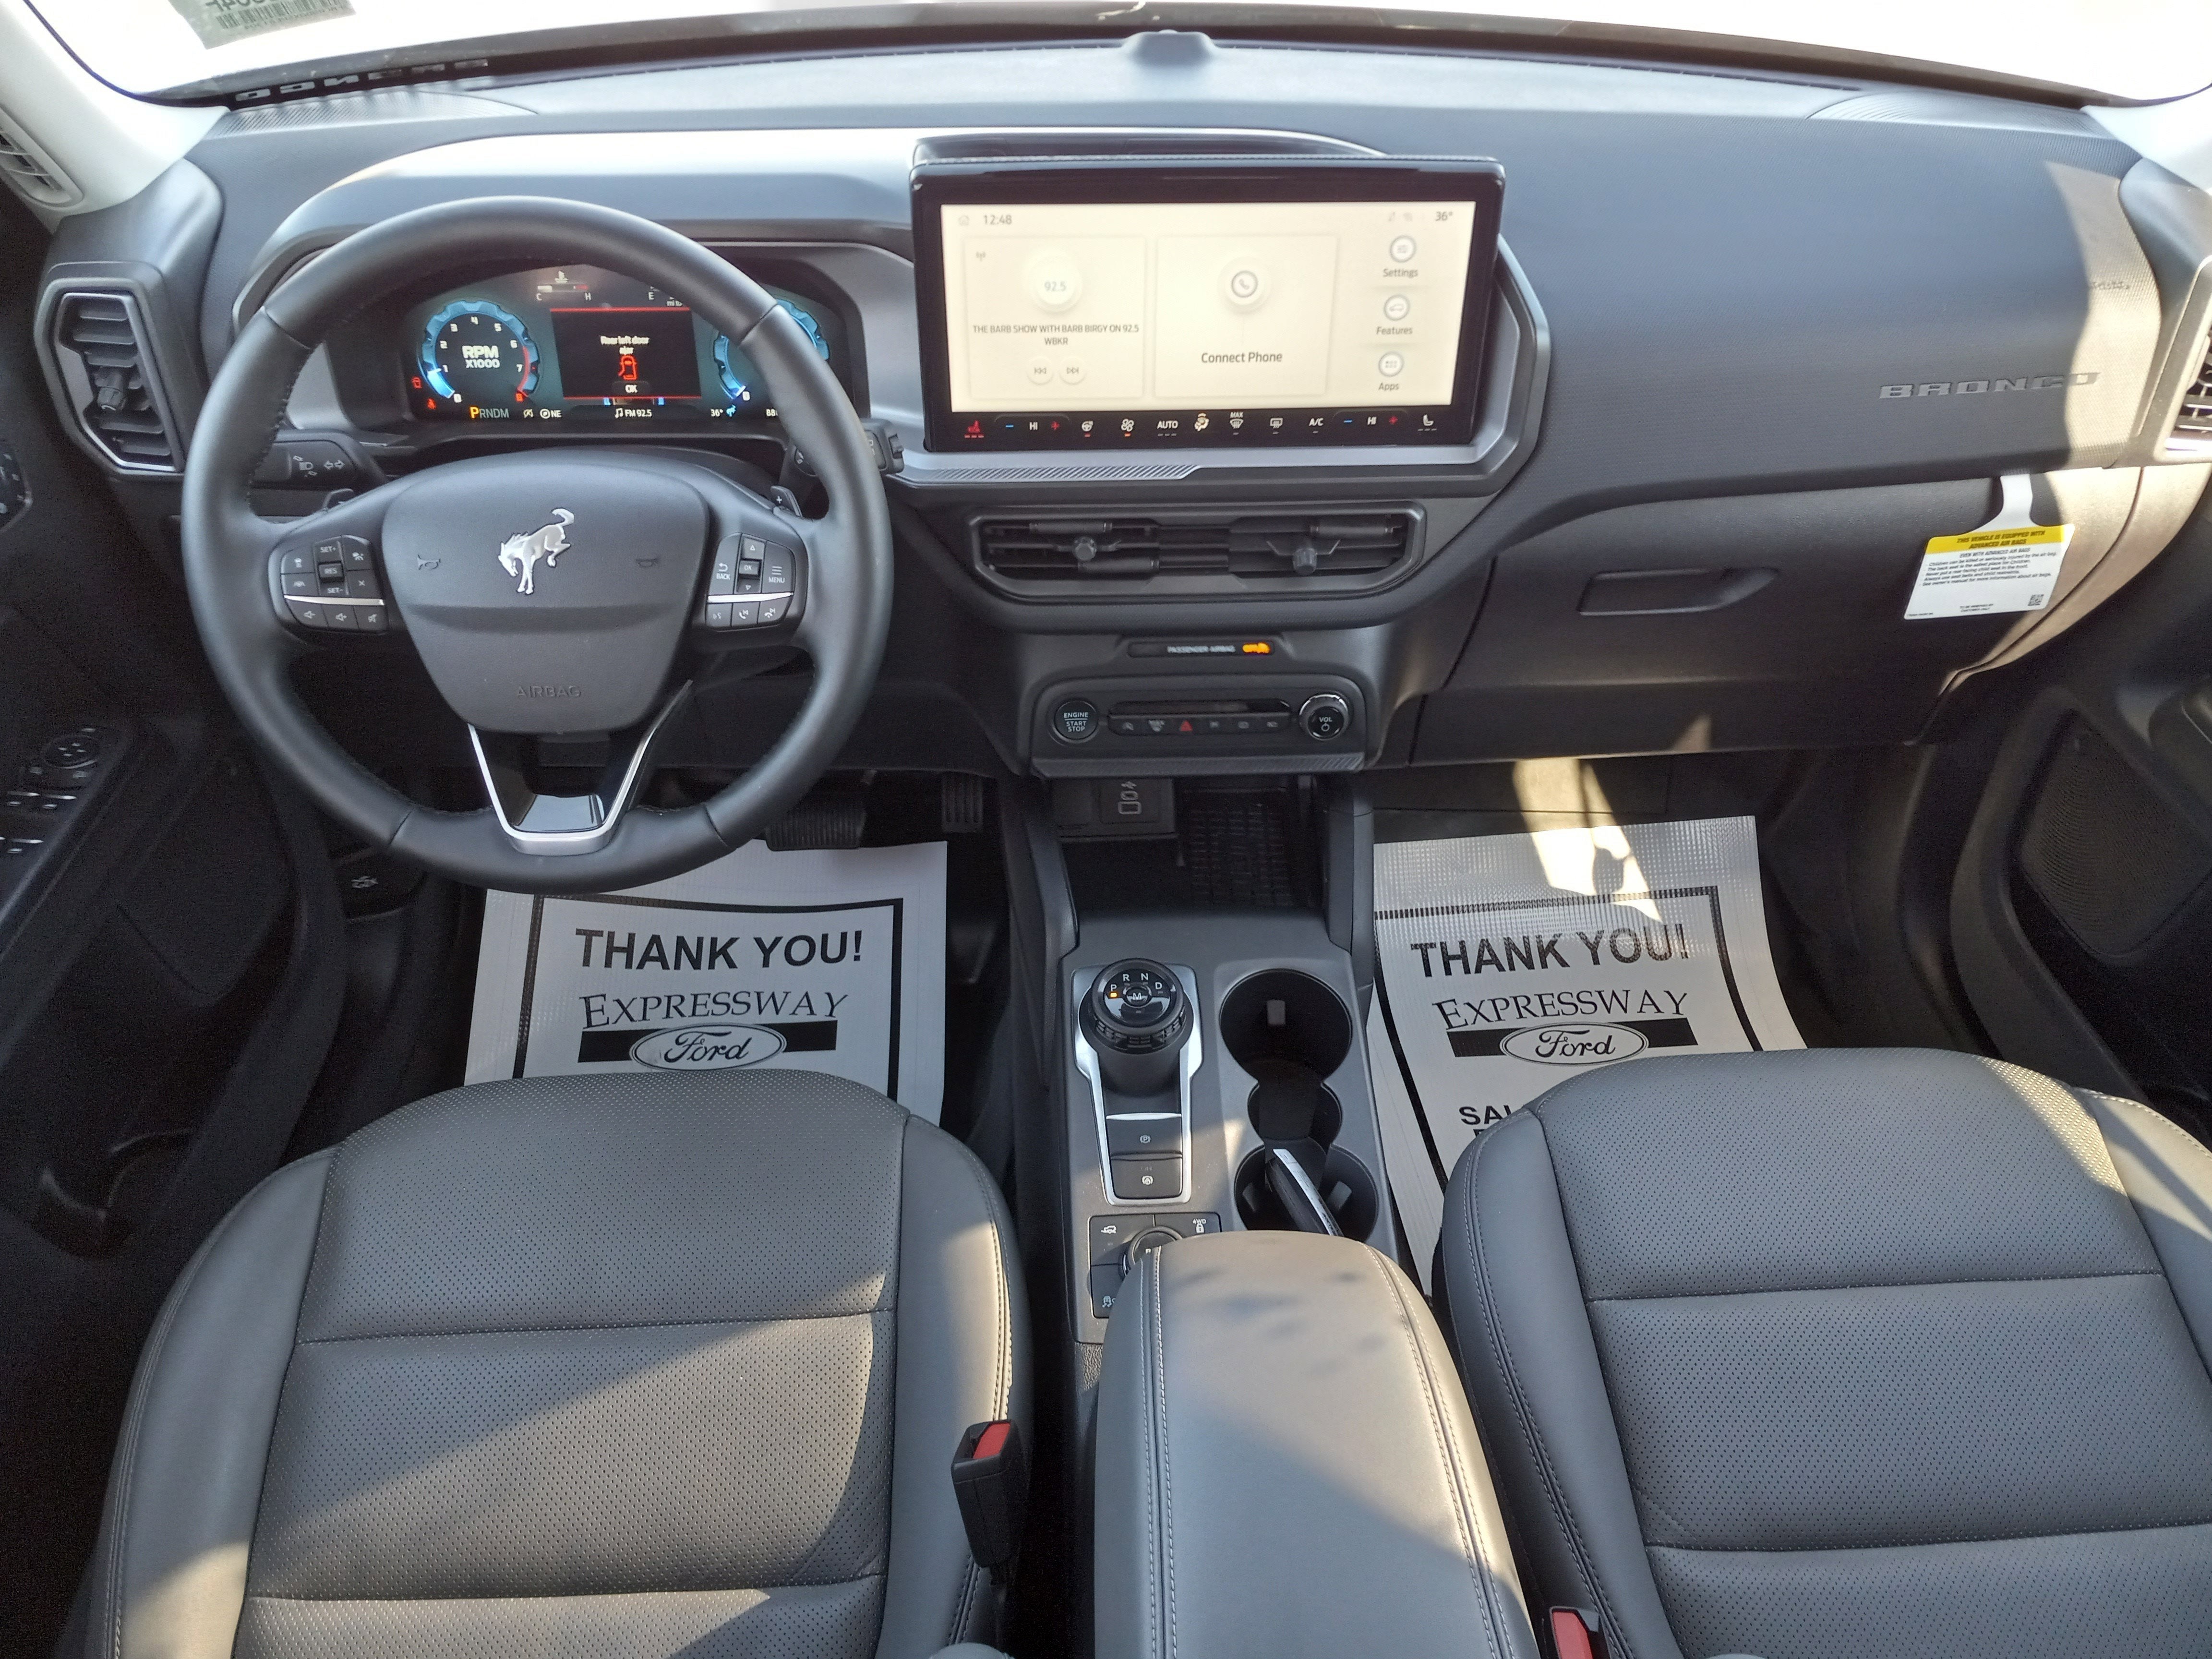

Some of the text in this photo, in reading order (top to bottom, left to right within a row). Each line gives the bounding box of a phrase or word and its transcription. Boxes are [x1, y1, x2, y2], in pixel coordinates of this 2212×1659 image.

[983, 215, 1012, 225] 12:48
[1383, 267, 1418, 279] Settings
[1044, 281, 1066, 292] 92.5
[585, 292, 591, 301] H
[649, 292, 654, 300] E
[470, 316, 479, 325] 4
[450, 324, 458, 332] 3
[494, 323, 502, 332] 5
[973, 325, 1139, 334] THE BARB SHOW WITH BARB BIRGY ON 92.5
[1376, 326, 1413, 336] Features
[440, 340, 448, 349] 2
[510, 340, 517, 349] 6
[1044, 337, 1069, 346] WBKR
[462, 346, 499, 358] RPM
[1201, 351, 1283, 364] Connect Phone
[466, 359, 500, 369] X1000
[516, 364, 524, 373] 7
[625, 385, 637, 393] OK
[1378, 382, 1399, 391] Apps
[1879, 373, 2100, 399] BRONCO
[453, 393, 462, 404] 0
[637, 409, 652, 417] 92.5
[1029, 421, 1038, 431] HI
[1157, 420, 1178, 429] AUTO
[1309, 417, 1323, 427] A/C
[1367, 416, 1377, 426] HI
[517, 685, 582, 697] AIRBAG
[577, 928, 863, 971] THANK YOU!
[1411, 923, 1688, 977] THANK YOU!
[579, 991, 849, 1029] EXPRESSWAY
[1432, 990, 1688, 1031] EXPRESSWAY
[664, 1030, 752, 1063] Ford
[1535, 1030, 1615, 1058] Ford
